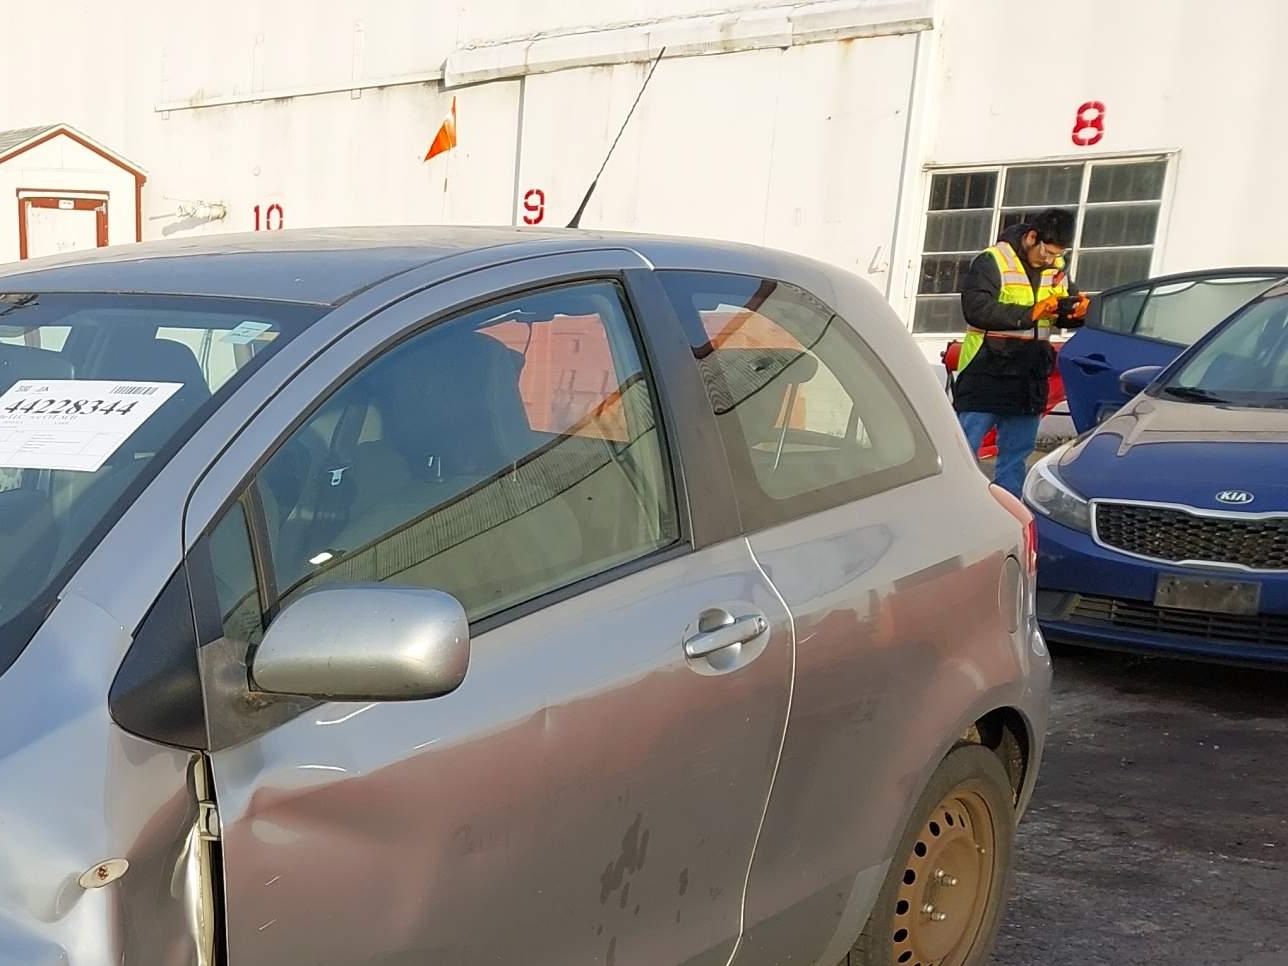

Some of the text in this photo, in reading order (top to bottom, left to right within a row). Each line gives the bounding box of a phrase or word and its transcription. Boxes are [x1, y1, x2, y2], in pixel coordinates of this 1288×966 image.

[1071, 100, 1106, 146] 8
[253, 203, 284, 231] 10
[523, 189, 545, 225] 9
[5, 398, 139, 415] 44228344
[1220, 491, 1247, 501] KIA
